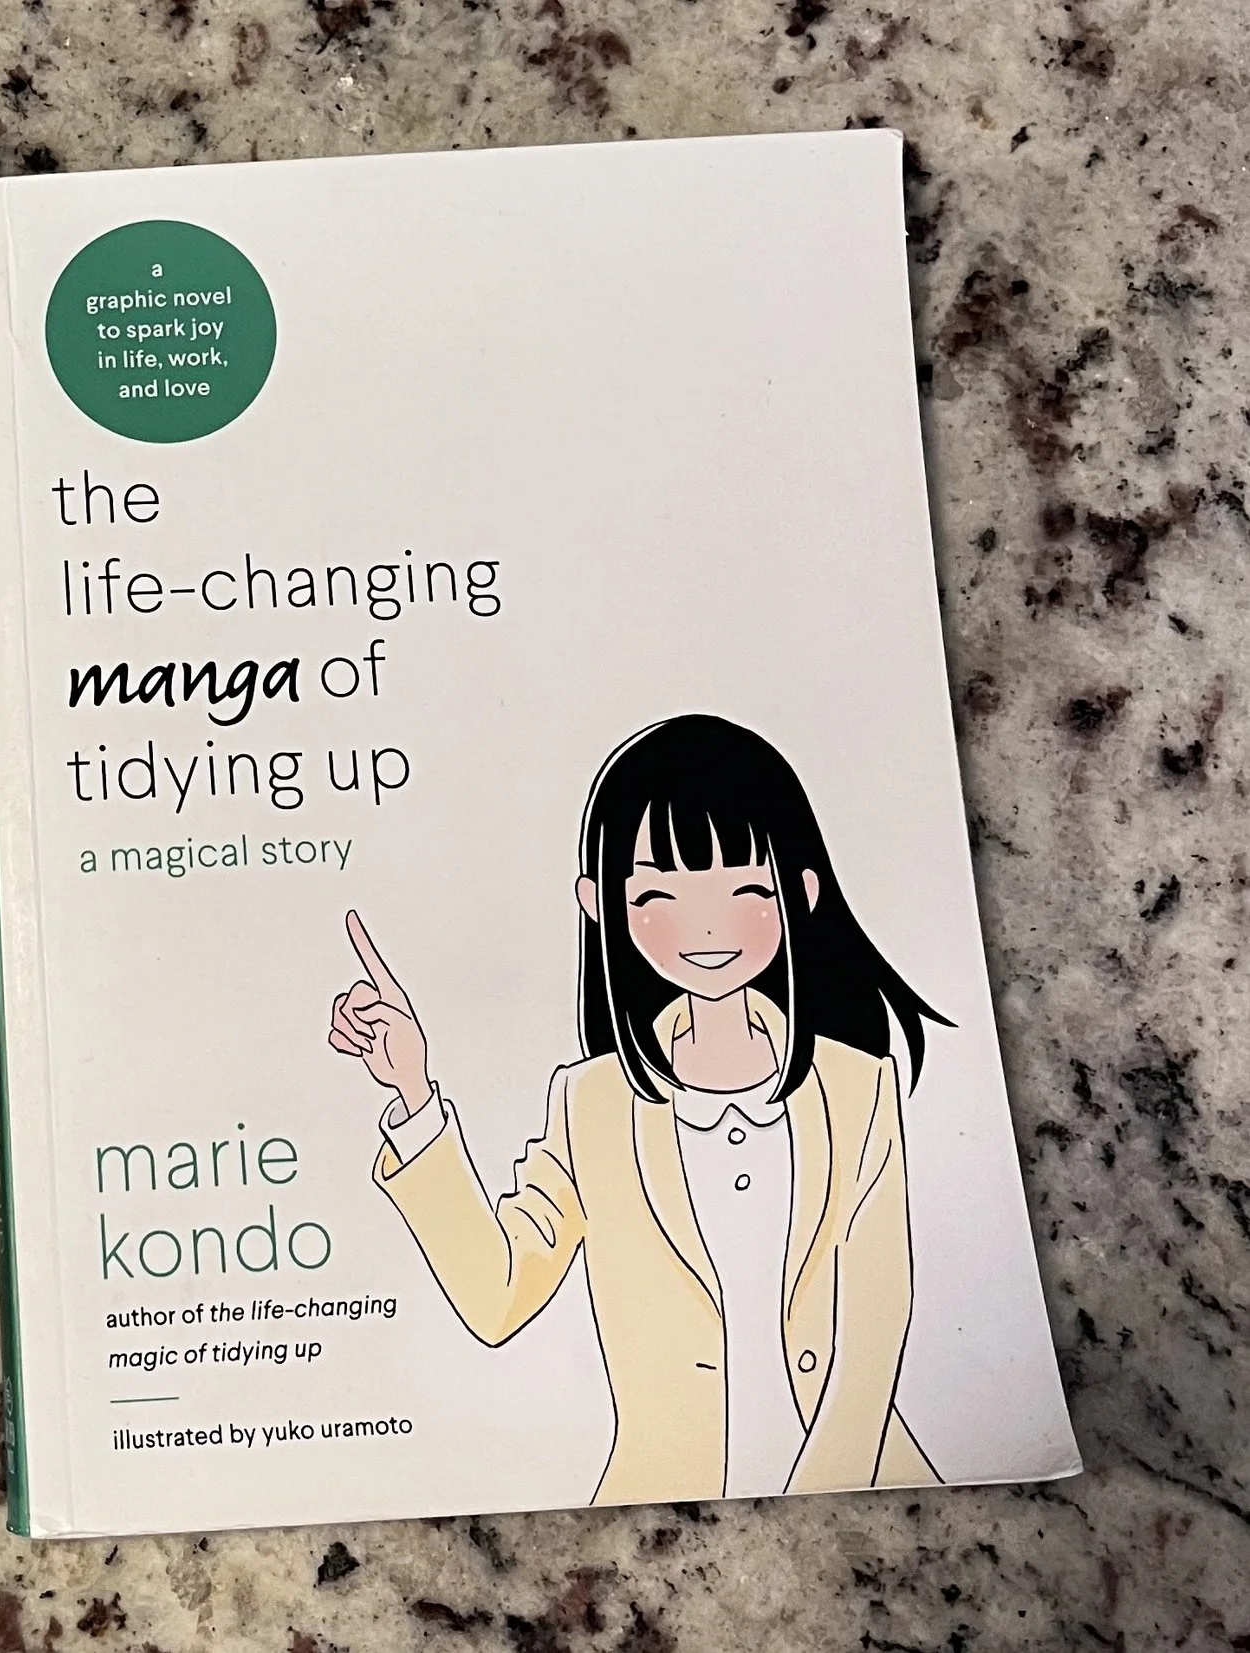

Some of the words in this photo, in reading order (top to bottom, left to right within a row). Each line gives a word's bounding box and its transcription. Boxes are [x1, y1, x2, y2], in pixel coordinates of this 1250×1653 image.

[152, 264, 162, 277] a
[87, 290, 166, 314] graphic
[174, 286, 231, 306] novel
[97, 324, 120, 339] to
[127, 319, 185, 342] spark
[190, 318, 223, 340] joy
[98, 351, 116, 368] in
[124, 350, 162, 369] life,
[168, 347, 227, 367] work,
[119, 380, 157, 398] and
[165, 379, 210, 396] love
[52, 470, 159, 525] the
[64, 550, 500, 620] life-changing
[69, 658, 299, 726] manga
[321, 639, 385, 697] of
[67, 741, 303, 813] tidying
[329, 748, 409, 805] up
[81, 851, 96, 873] a
[112, 835, 247, 877] magical
[262, 838, 351, 870] story
[97, 1123, 297, 1192] marie
[101, 1205, 331, 1279] kondo
[107, 1307, 175, 1328] author
[182, 1303, 203, 1323] of
[210, 1302, 244, 1322] the
[252, 1295, 396, 1320] life-changing
[109, 1346, 177, 1371] magic
[185, 1343, 207, 1363] of
[213, 1341, 287, 1366] tidying
[296, 1343, 321, 1362] up
[114, 1424, 222, 1449] illustrated
[230, 1424, 255, 1448] by
[262, 1420, 314, 1447] yuko
[322, 1417, 412, 1438] uramoto
